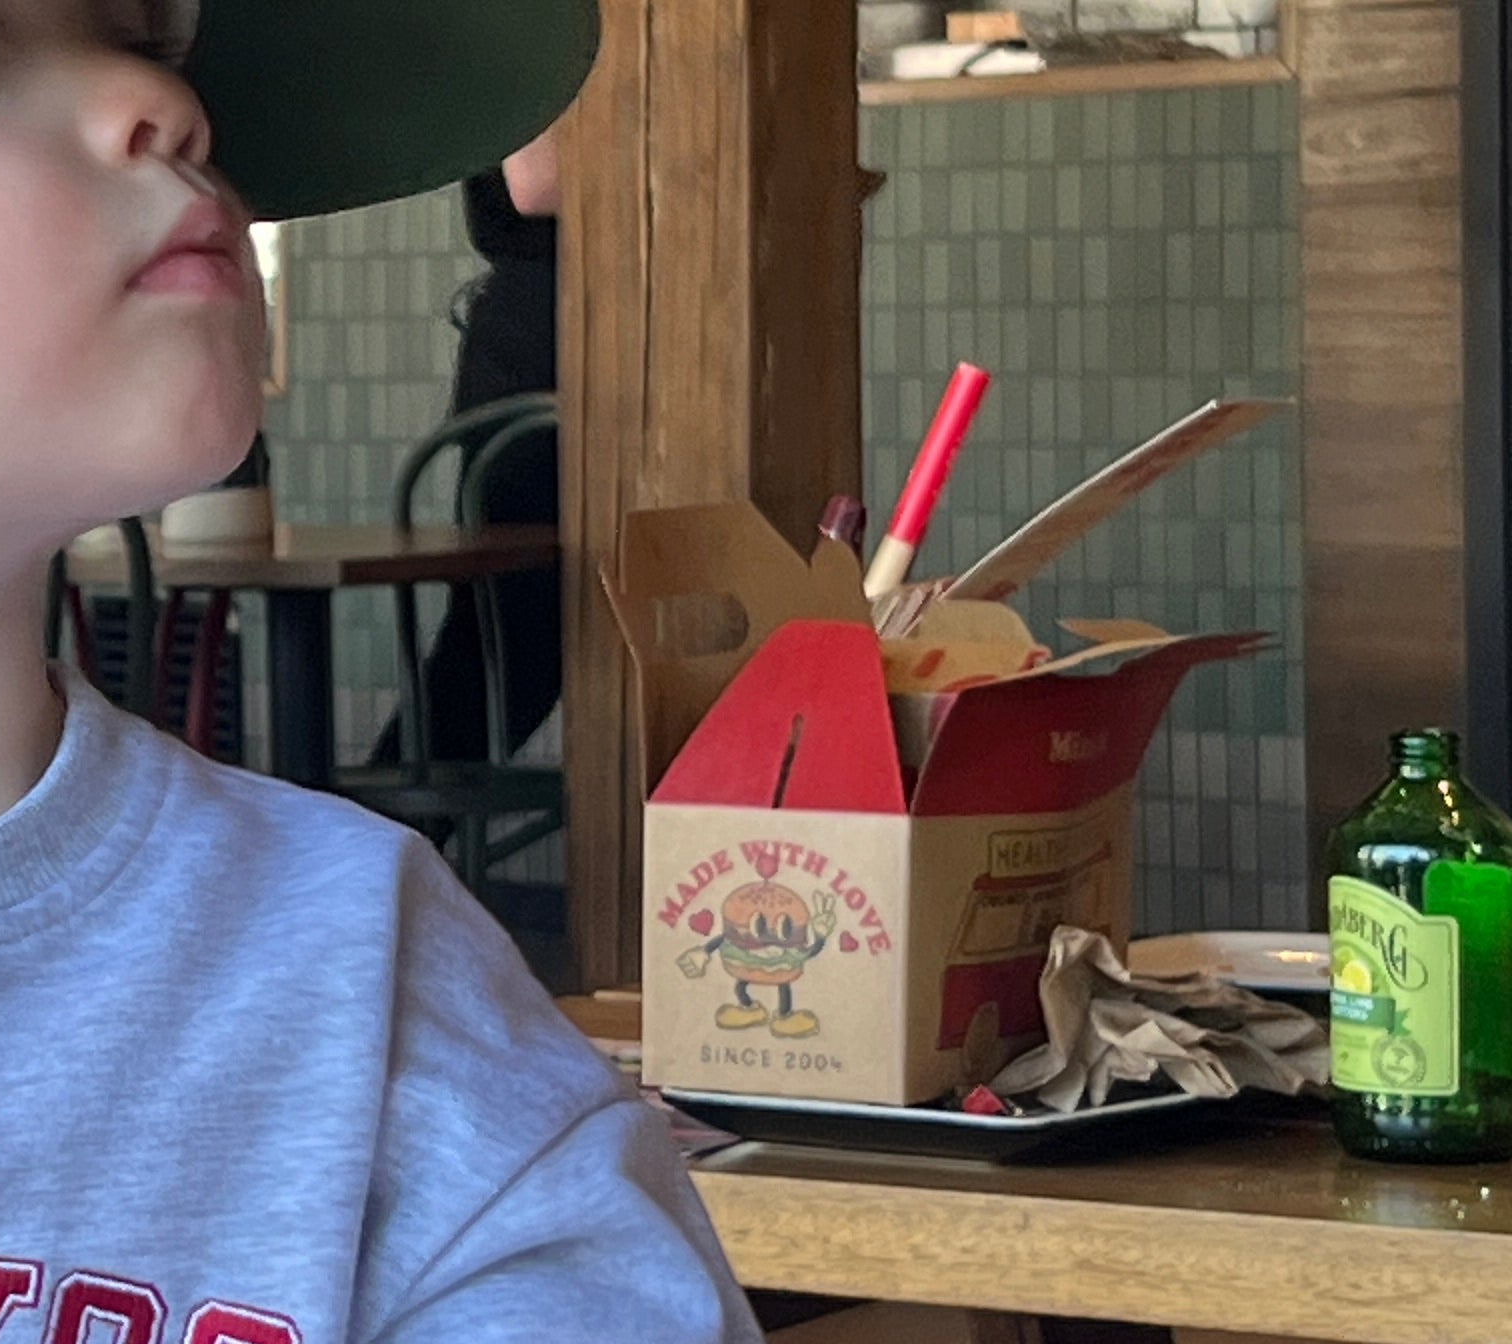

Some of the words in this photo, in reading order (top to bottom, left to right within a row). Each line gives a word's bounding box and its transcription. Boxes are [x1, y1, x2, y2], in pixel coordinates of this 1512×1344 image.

[657, 849, 734, 929] MADE
[740, 840, 829, 878] WITH
[829, 868, 893, 956] LOVE
[700, 1045, 772, 1068] SINCE
[785, 1052, 843, 1073] 2004
